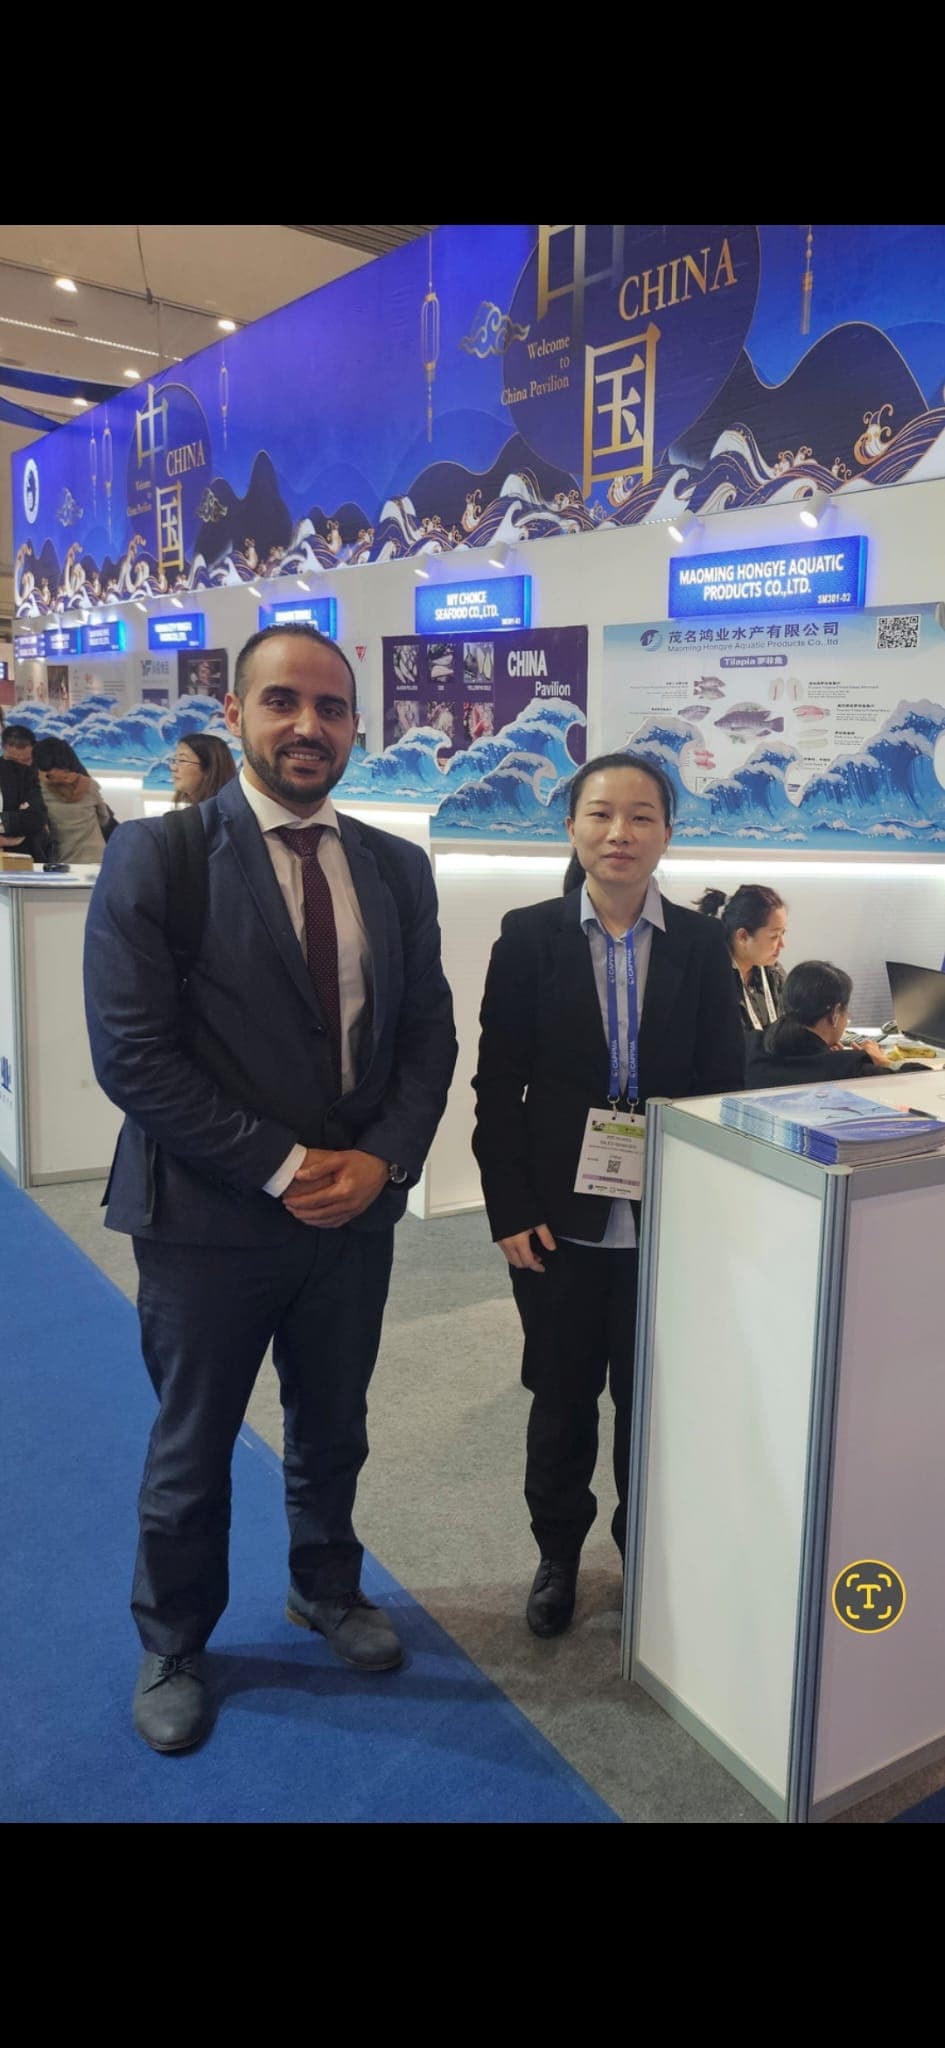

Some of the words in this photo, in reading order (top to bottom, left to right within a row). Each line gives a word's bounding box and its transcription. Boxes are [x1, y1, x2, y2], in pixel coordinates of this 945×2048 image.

[618, 238, 738, 321] CHINA
[527, 333, 570, 361] Welcome
[559, 355, 570, 369] to
[500, 388, 527, 407] China
[529, 374, 570, 400] Pavilion
[583, 322, 661, 499] 国
[136, 384, 168, 475] 中
[166, 440, 206, 478] CHINA
[156, 480, 183, 576] 国
[679, 566, 734, 586] MAOMING
[737, 561, 786, 580] HONGYE
[788, 553, 845, 576] AQUATIC
[459, 590, 487, 605] CHOICE
[703, 581, 762, 601] PRODUCTS
[764, 577, 812, 599] CO.,LTD.
[435, 606, 467, 621] SEAFOOD
[668, 621, 840, 644] 茂名鸿业水产有限公司
[668, 644, 702, 653] Maoming
[703, 643, 733, 652] Hongye
[735, 641, 766, 650] Aquatic
[767, 639, 805, 648] Products
[507, 650, 548, 678] CHINA
[724, 657, 756, 667] Tilapia
[535, 681, 570, 697] Pavilion
